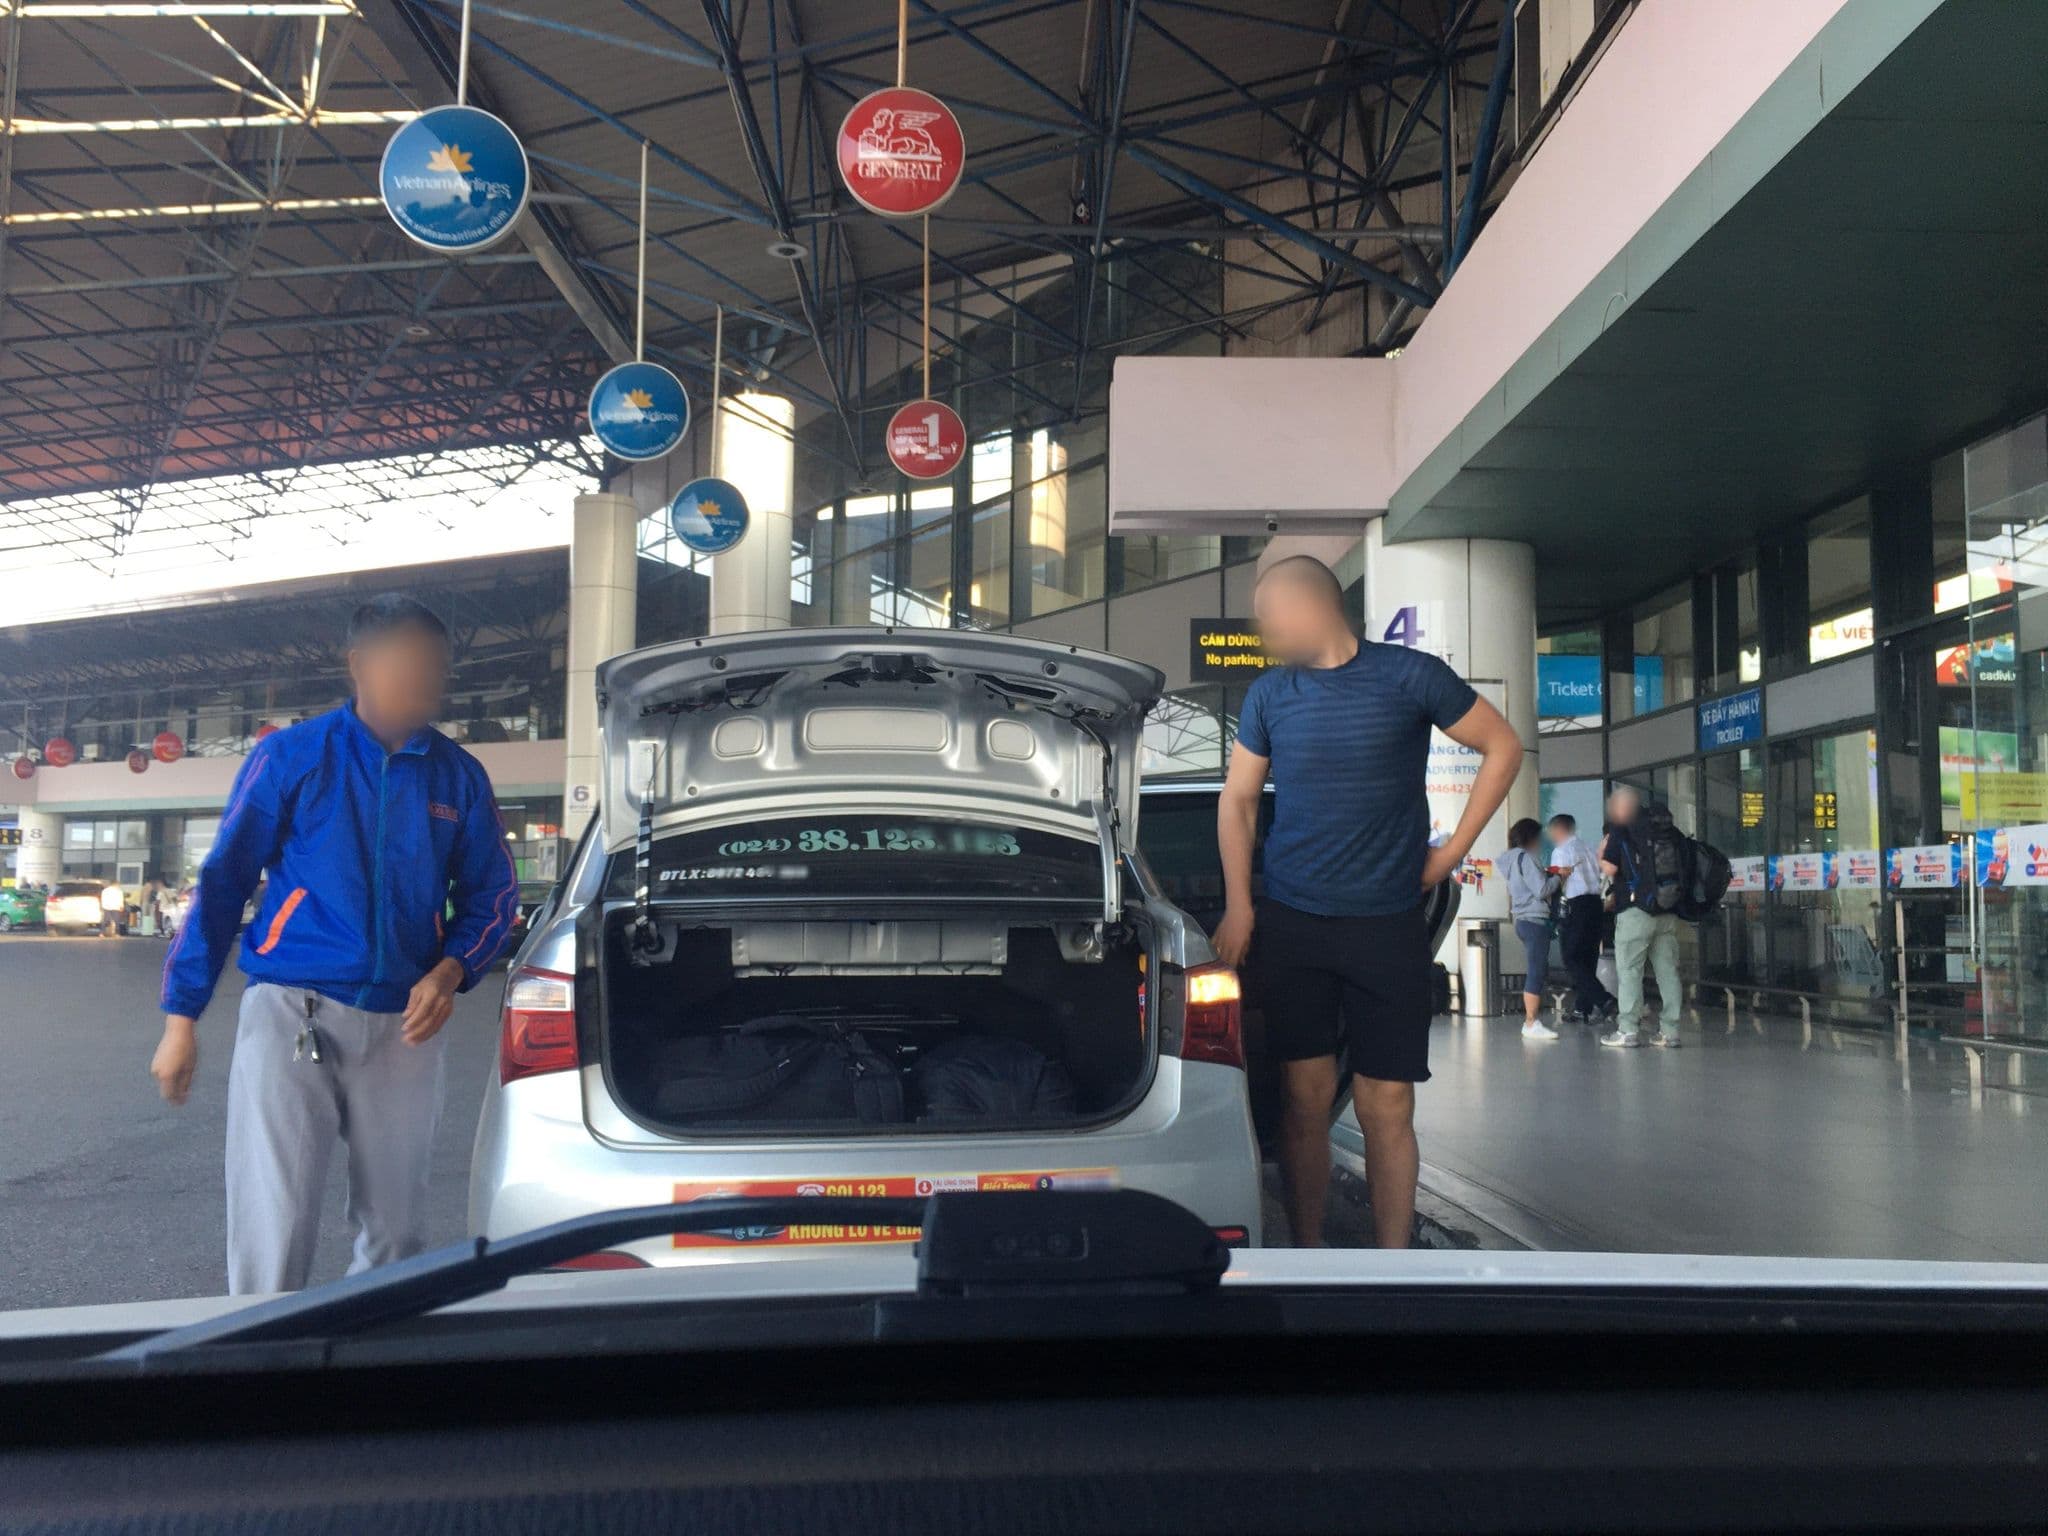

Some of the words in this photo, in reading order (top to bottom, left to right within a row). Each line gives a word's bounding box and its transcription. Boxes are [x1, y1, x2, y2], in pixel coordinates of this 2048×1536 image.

[858, 161, 942, 181] GENERALI
[394, 175, 454, 190] Vietnam
[455, 177, 511, 197] Airlines
[1383, 606, 1425, 647] 4
[1206, 653, 1221, 664] No
[1224, 653, 1264, 667] parking
[1548, 682, 1593, 697] Ticket
[1717, 726, 1744, 744] TROLLEY
[573, 785, 589, 802] 6
[30, 828, 43, 839] 8
[718, 838, 791, 856] (024)
[858, 1184, 886, 1197] 123
